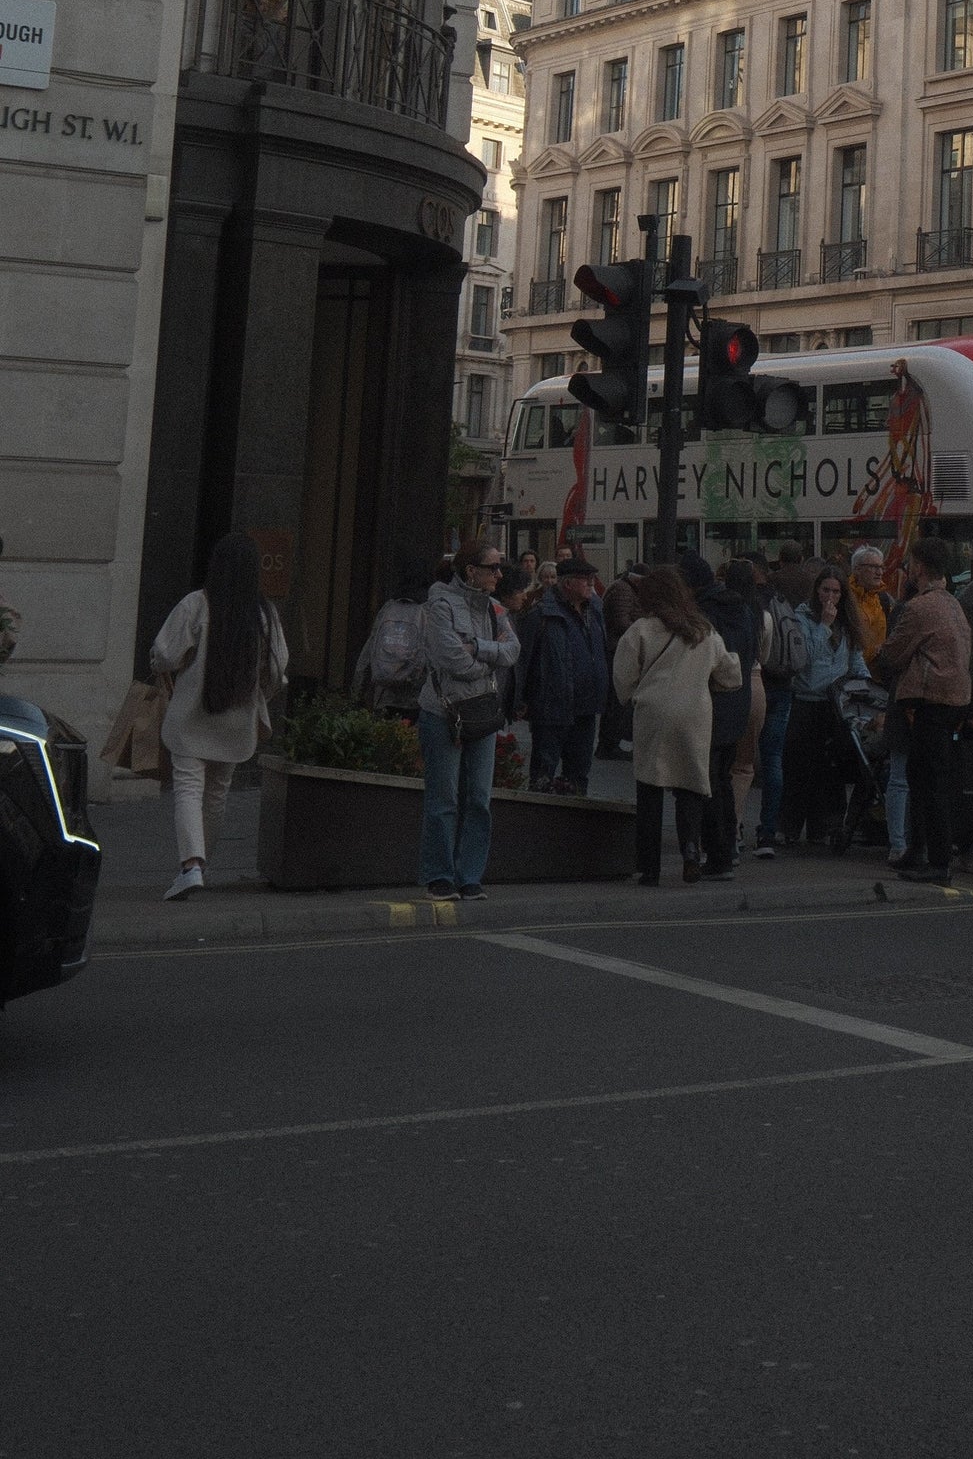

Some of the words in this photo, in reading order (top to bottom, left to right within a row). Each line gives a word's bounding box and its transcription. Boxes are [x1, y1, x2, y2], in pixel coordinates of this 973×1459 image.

[61, 114, 93, 140] ST.
[725, 456, 882, 498] NICHOLS
[261, 554, 284, 571] OS
